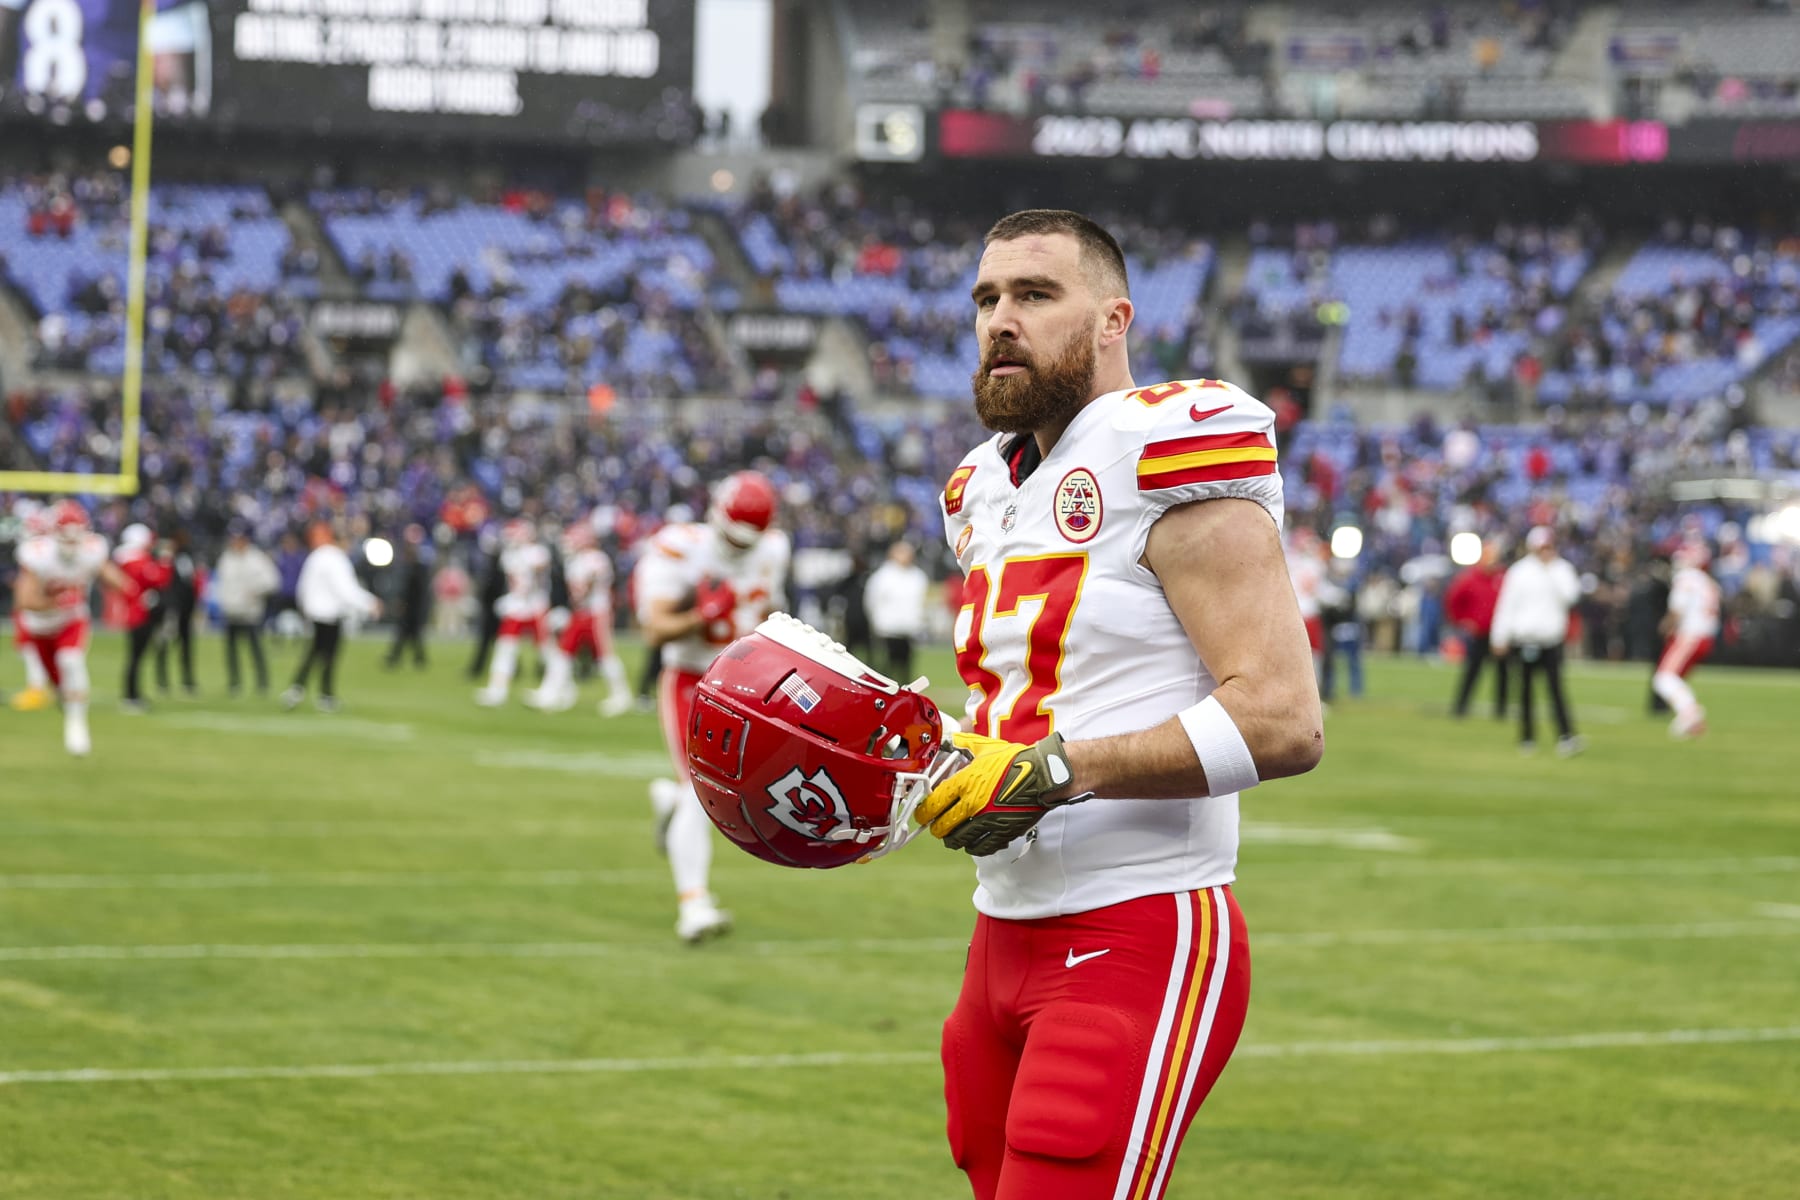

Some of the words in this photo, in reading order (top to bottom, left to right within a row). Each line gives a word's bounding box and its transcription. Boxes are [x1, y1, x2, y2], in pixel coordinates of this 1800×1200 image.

[24, 0, 86, 100] 8
[1033, 116, 1123, 157] 2023
[1124, 118, 1199, 159] AFC
[1200, 119, 1323, 160] NORTH
[1327, 121, 1538, 161] CHAMPIONS
